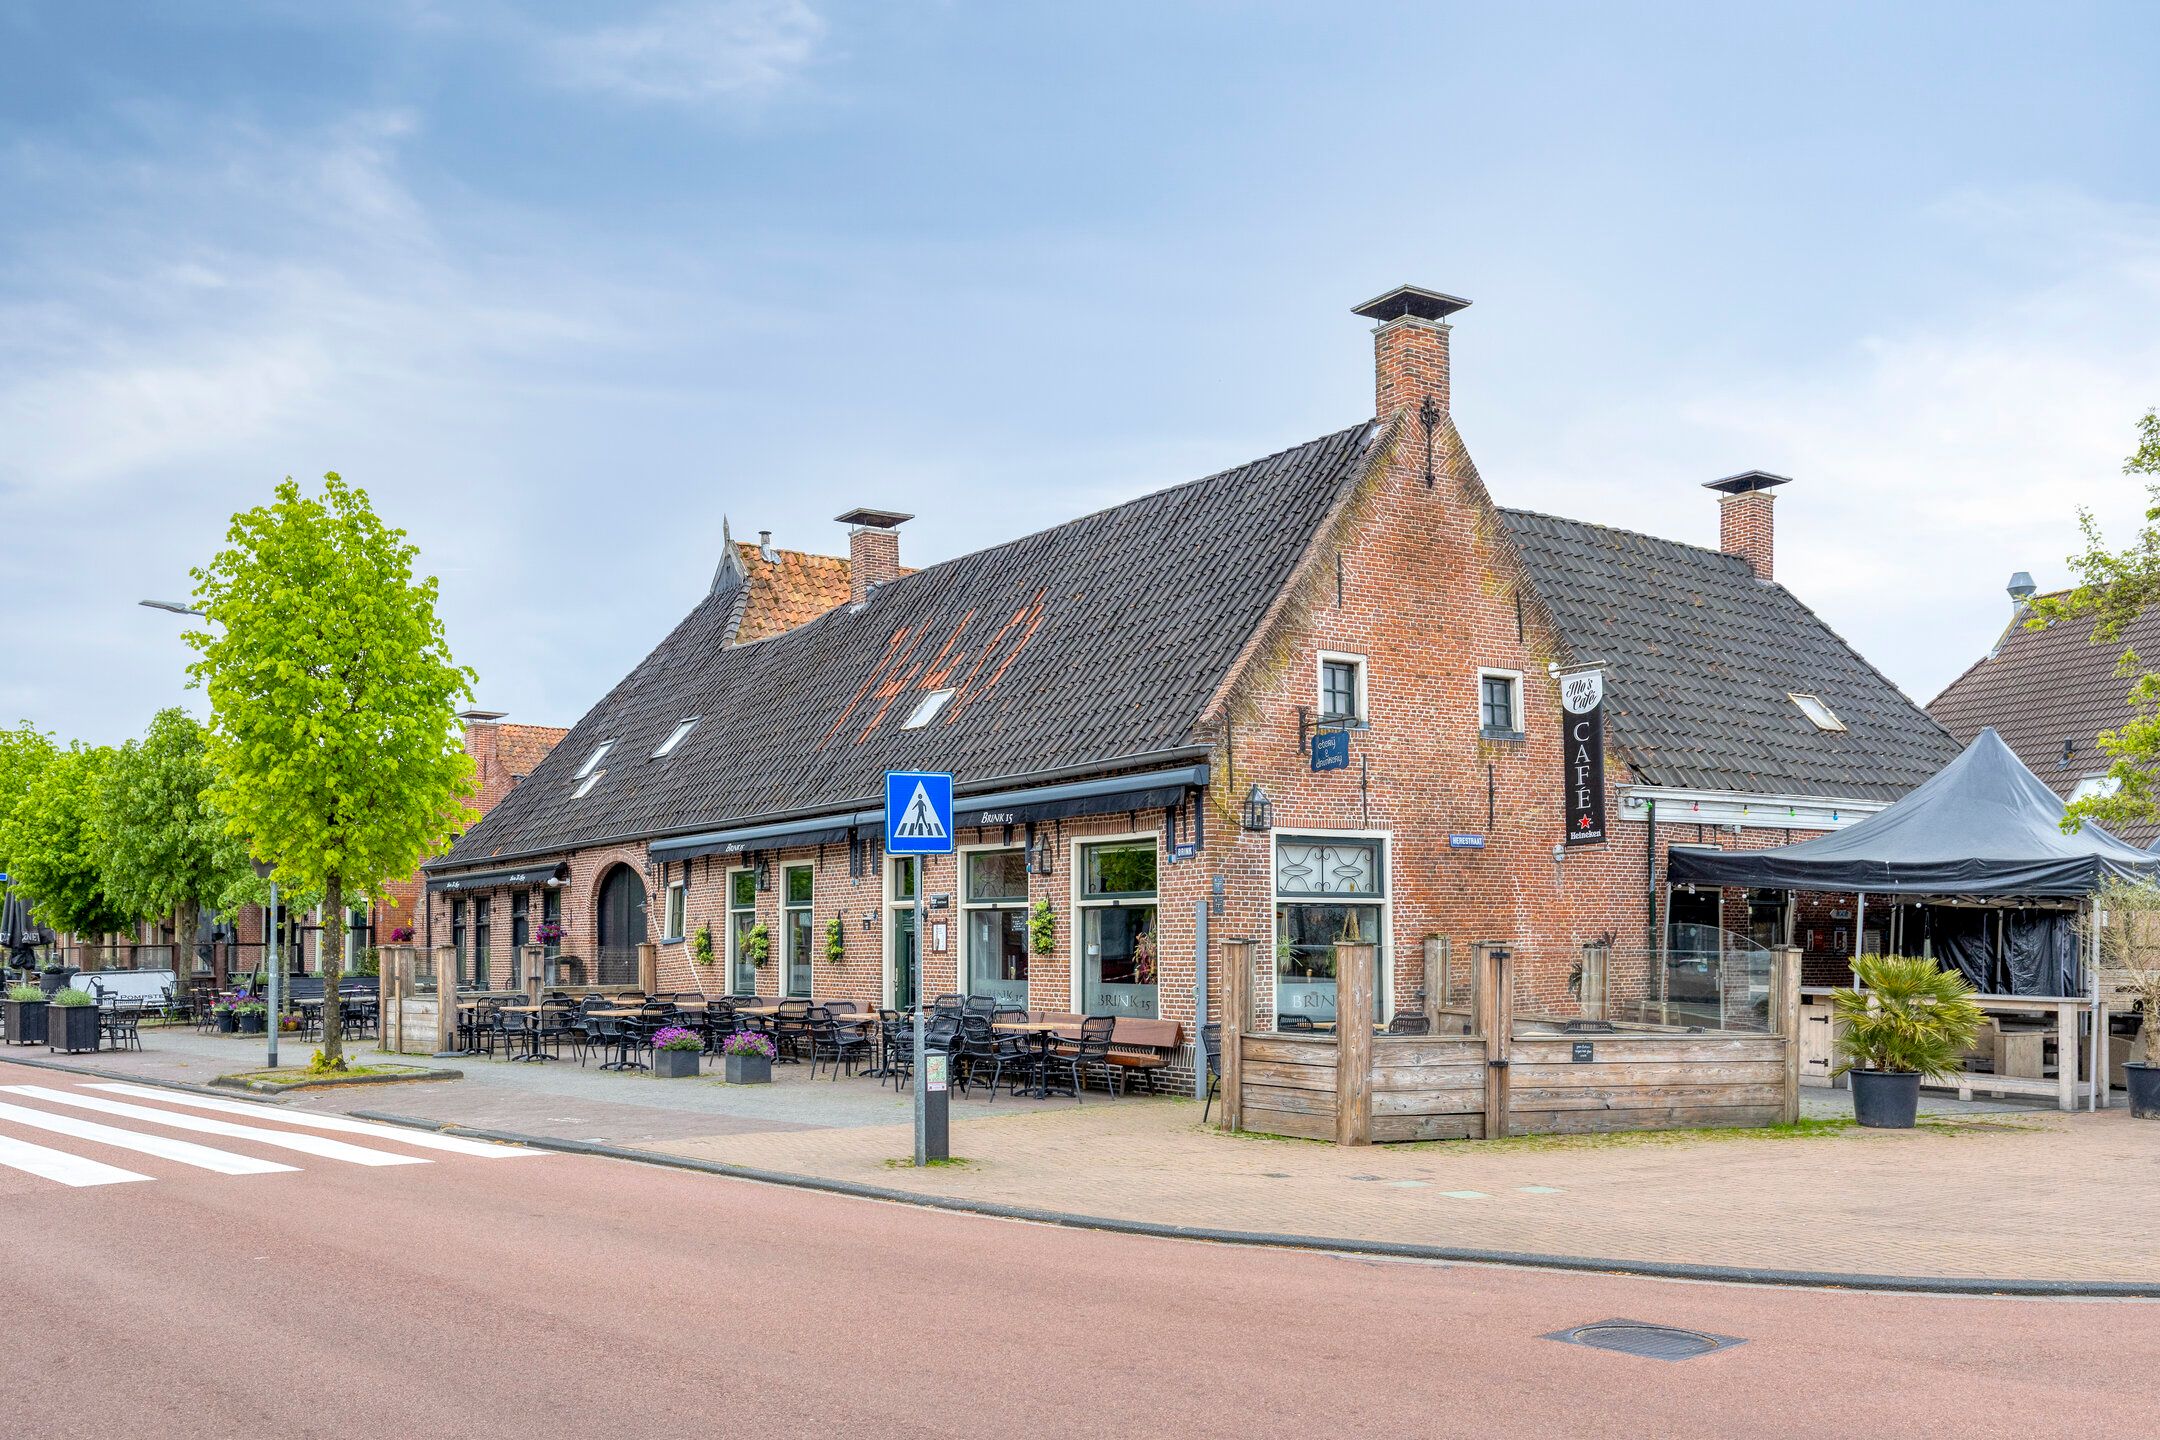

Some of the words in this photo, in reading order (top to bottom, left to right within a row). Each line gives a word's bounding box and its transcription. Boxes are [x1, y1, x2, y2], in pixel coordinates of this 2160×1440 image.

[1566, 678, 1593, 698] Mo's
[1572, 690, 1597, 710] Café
[1573, 721, 1592, 810] CAFÉ
[981, 811, 1004, 823] BRINK
[1005, 813, 1014, 824] 15
[1452, 836, 1483, 846] HERESTRAAT
[1570, 829, 1602, 840] Heineken
[1177, 846, 1193, 857] BRINK
[120, 993, 164, 1001] POMPSTE
[1097, 993, 1139, 1008] BRINK
[1141, 999, 1152, 1011] 15
[1292, 994, 1335, 1009] BRIN
